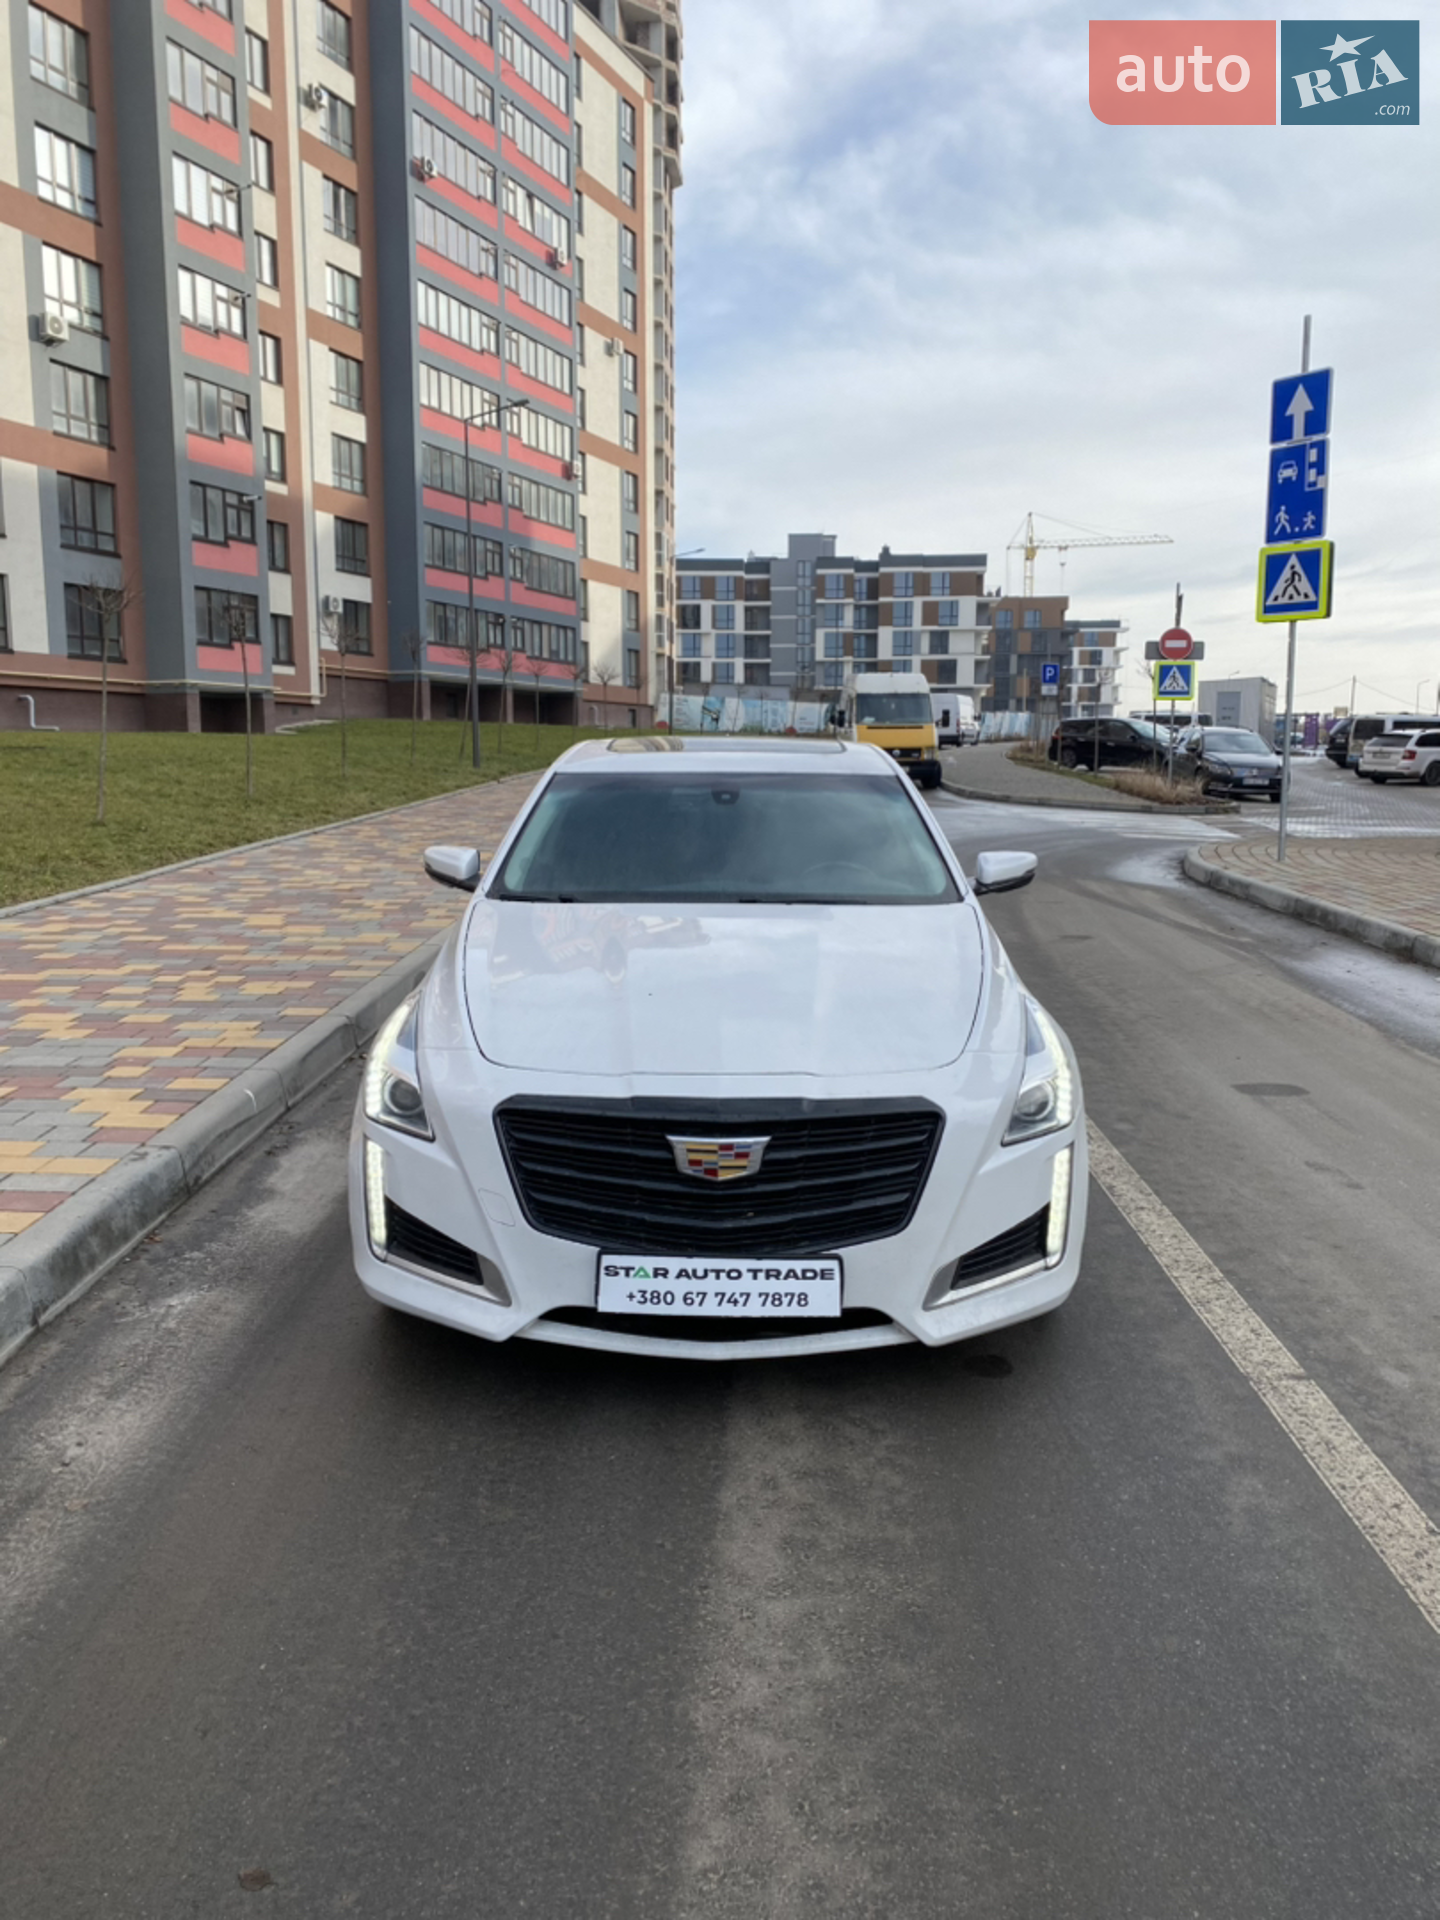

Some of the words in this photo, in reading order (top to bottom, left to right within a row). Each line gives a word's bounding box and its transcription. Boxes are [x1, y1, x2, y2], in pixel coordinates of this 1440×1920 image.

[1045, 666, 1055, 681] P
[603, 1265, 669, 1279] STAR
[675, 1268, 743, 1280] AUTO
[747, 1268, 835, 1280] TRADE
[626, 1290, 675, 1306] +380
[682, 1291, 708, 1307] 67
[714, 1292, 751, 1307] 747
[758, 1292, 809, 1308] 7878
